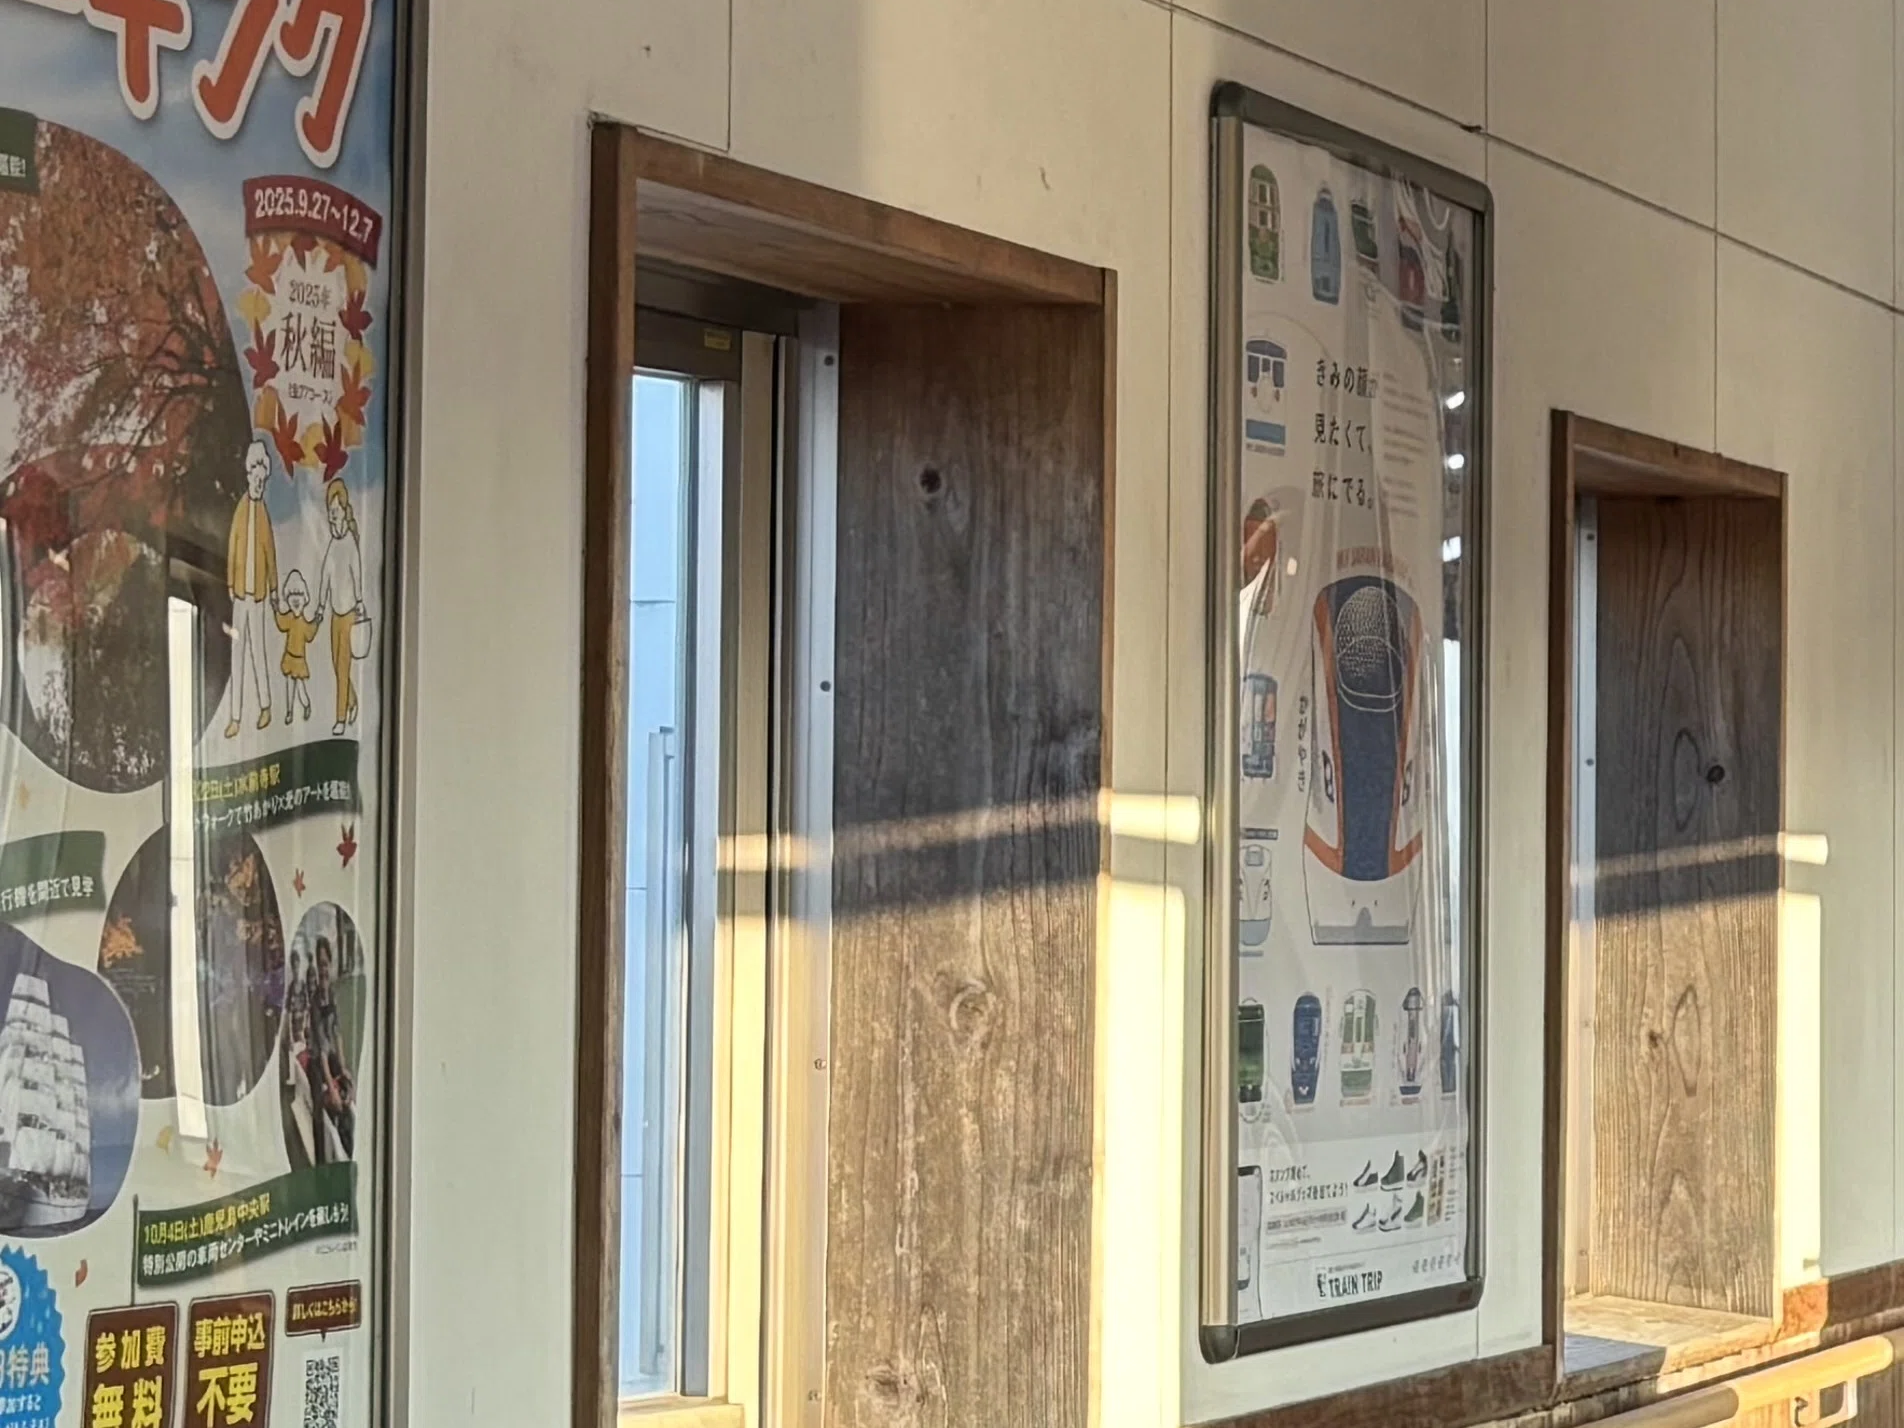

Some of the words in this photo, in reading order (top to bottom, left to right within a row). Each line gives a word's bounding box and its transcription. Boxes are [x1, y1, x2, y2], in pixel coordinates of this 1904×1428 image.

[279, 312, 336, 380] 秋編
[1328, 1274, 1359, 1298] TRAIN
[1361, 1270, 1383, 1293] TRIP
[95, 1325, 166, 1373] 参加費
[194, 1312, 266, 1358] 事前申込
[196, 1362, 259, 1428] 不要
